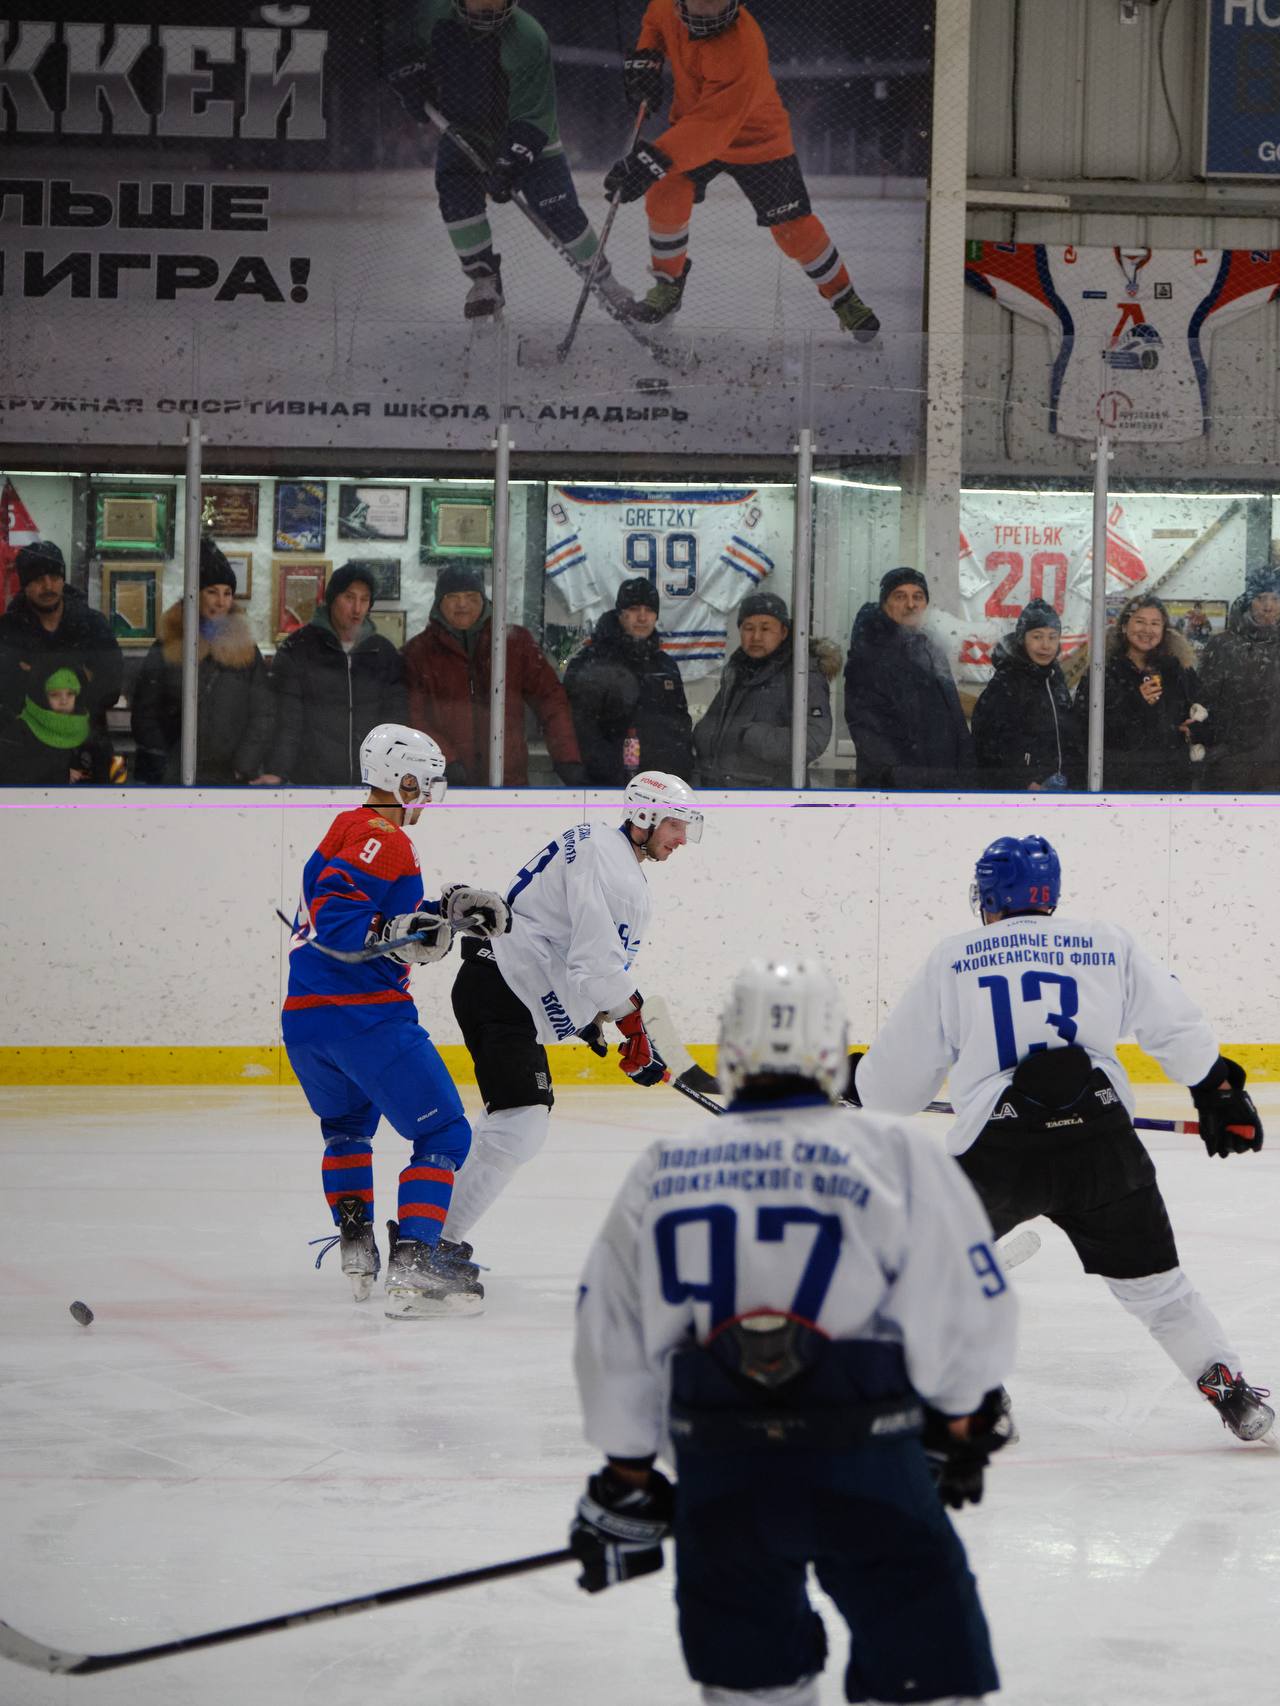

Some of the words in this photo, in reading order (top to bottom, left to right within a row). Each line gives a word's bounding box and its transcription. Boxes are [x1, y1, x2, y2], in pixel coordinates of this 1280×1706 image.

[23, 250, 312, 304] ИГРА!
[0, 398, 143, 414] РУЖНАЯ
[383, 402, 490, 419] ШКОЛА
[538, 405, 690, 422] АНАДЫРЬ
[626, 507, 698, 528] GRETZKY
[993, 525, 1064, 547] ТРЕТЬЯК
[624, 531, 699, 598] 99
[984, 551, 1069, 619] 20
[640, 777, 669, 791] FONBET
[359, 837, 382, 864] 9
[1030, 886, 1051, 904] 26
[965, 934, 1048, 955] ПОДВОДНЫЕ
[1054, 934, 1093, 949] СИЛЫ
[1070, 951, 1116, 967] ФЛОТА
[770, 1004, 796, 1029] 97
[977, 970, 1079, 1072] 13
[1044, 1117, 1084, 1129] TACKLA
[654, 1203, 843, 1340] 97
[966, 1240, 1007, 1299] 9
